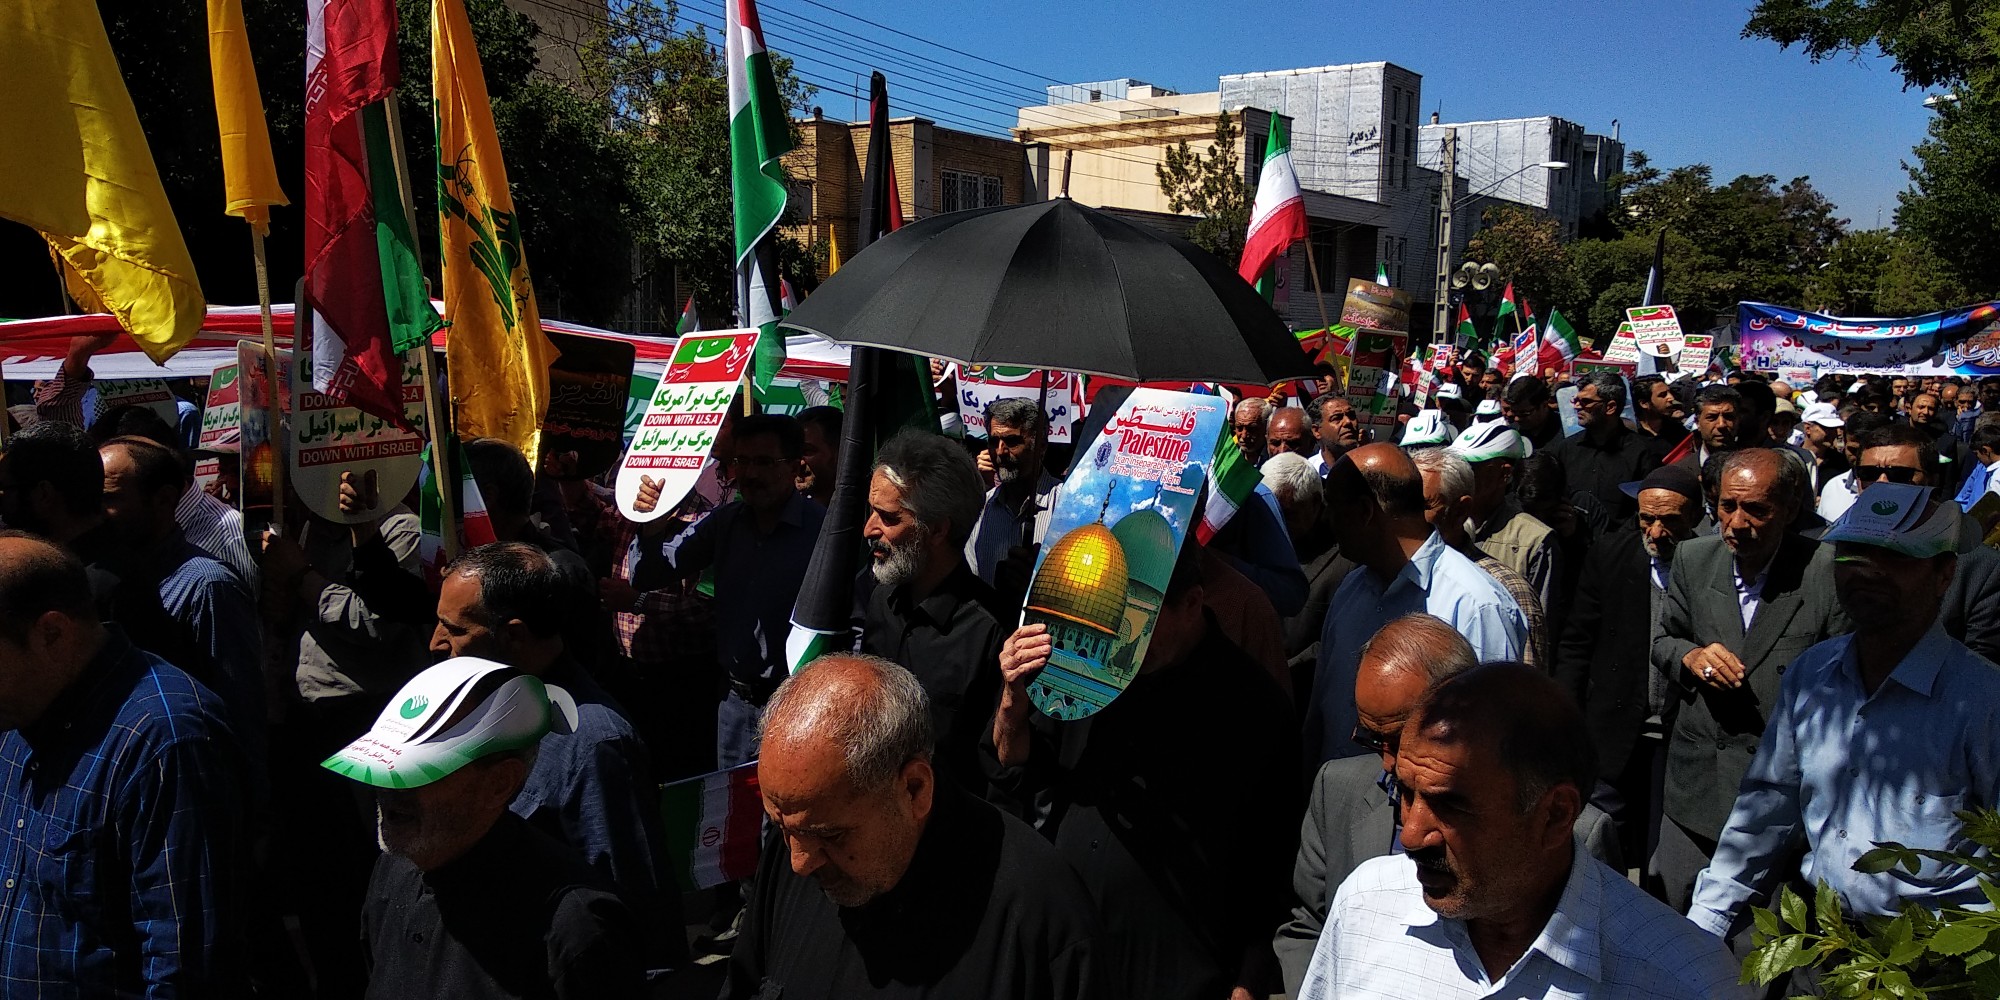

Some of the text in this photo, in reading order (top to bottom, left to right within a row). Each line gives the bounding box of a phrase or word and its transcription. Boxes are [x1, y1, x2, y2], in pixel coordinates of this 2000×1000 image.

[1750, 314, 1917, 336] روز جهانی قدس
[653, 386, 731, 412] مرگ بر آمریکا
[647, 415, 719, 426] DOWN WITH U.S.A
[963, 414, 986, 428] DOW
[1103, 405, 1197, 436] فلسطین
[633, 429, 713, 452] مرگ بر اسرائیل
[1118, 429, 1191, 463] Palestine
[302, 441, 419, 464] DOWN WITH ISRAEL
[627, 457, 700, 468] DOWN WITH ISRAEL
